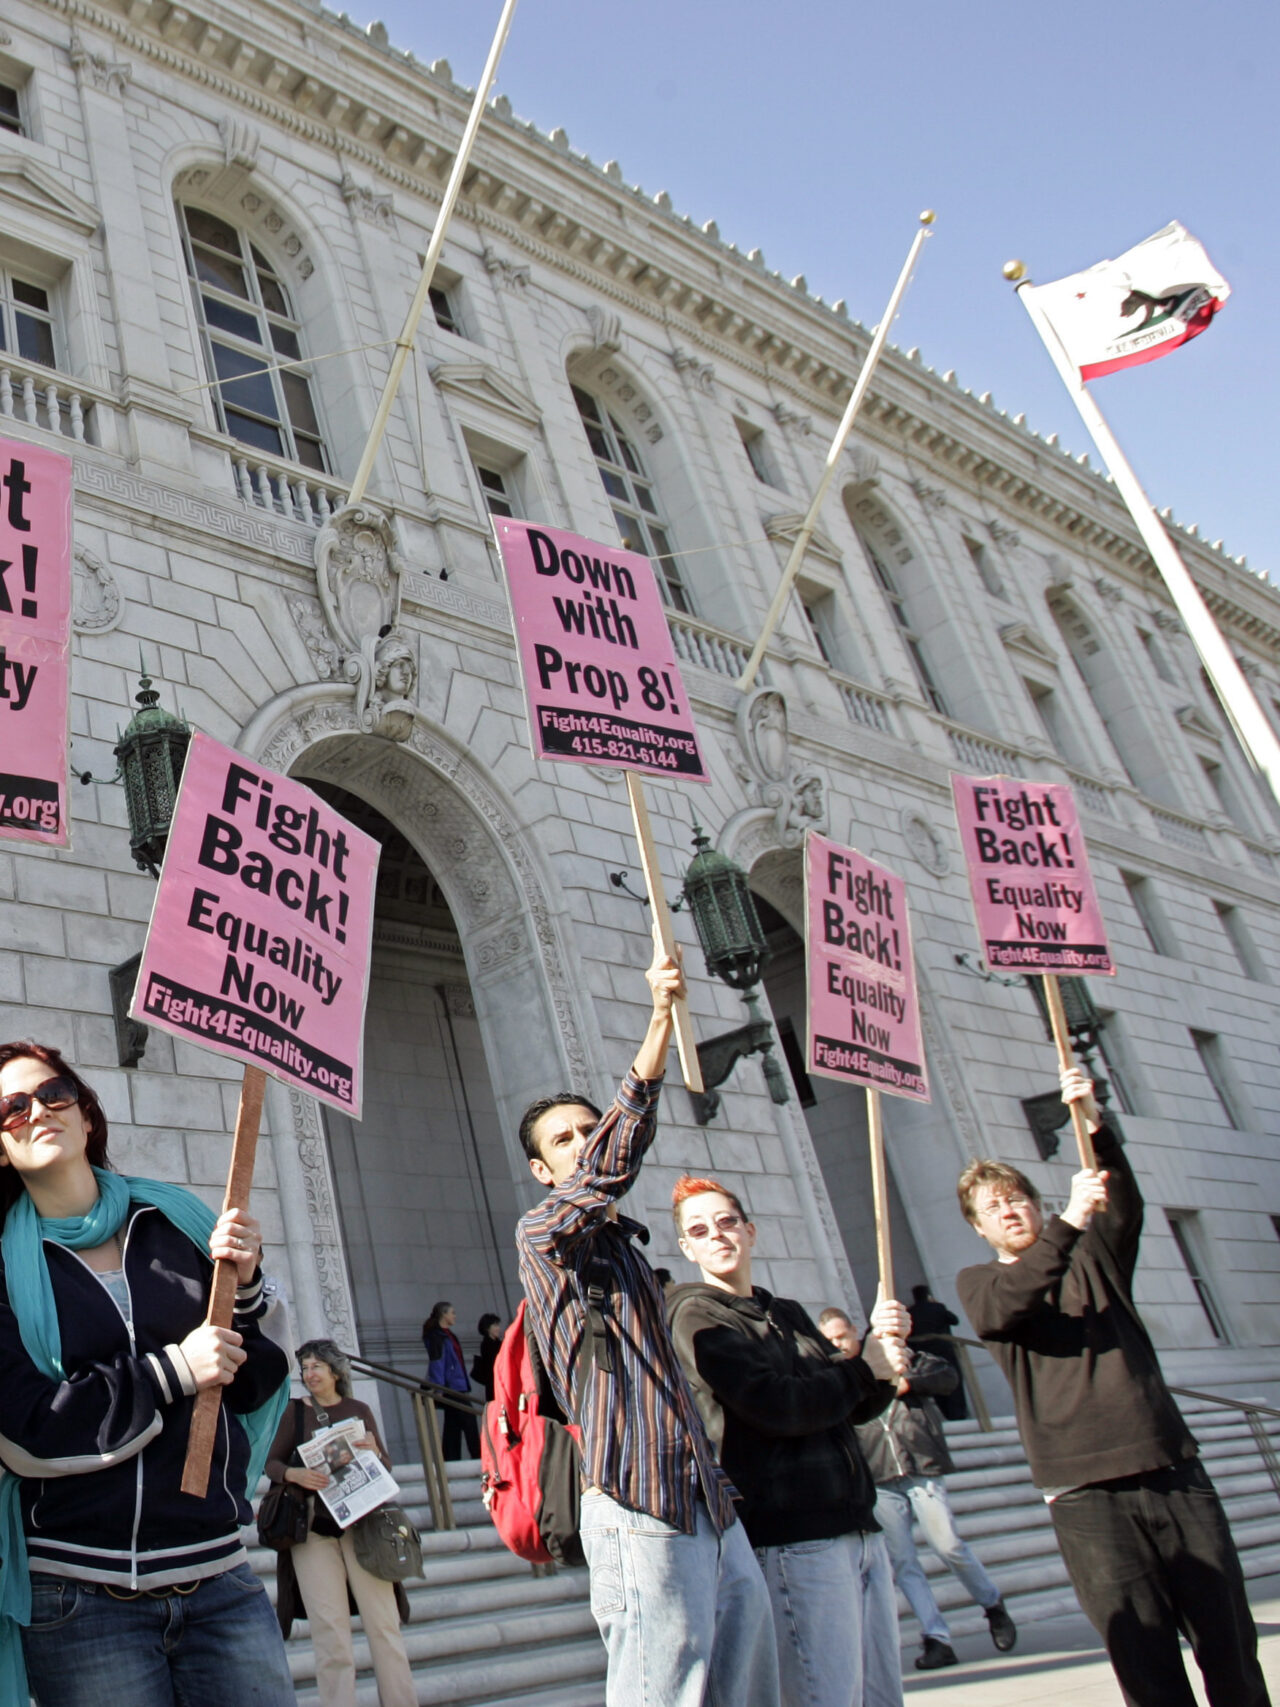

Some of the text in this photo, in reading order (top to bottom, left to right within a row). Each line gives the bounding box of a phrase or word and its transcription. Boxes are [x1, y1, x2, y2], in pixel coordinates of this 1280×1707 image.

[526, 528, 637, 600] Down
[552, 590, 639, 649] with
[534, 643, 680, 715] Prop 8!
[540, 710, 695, 755] Fight4Equality.org
[571, 736, 678, 768] 415-821-6144
[222, 762, 350, 883] Fight
[972, 787, 1061, 831] Fight
[974, 827, 1075, 868] Back!
[198, 813, 350, 945] Back!
[827, 851, 894, 921] Fight
[986, 878, 1083, 913] Equality
[187, 887, 342, 1005] Equality
[823, 899, 902, 971] Back!
[1016, 913, 1066, 940] Now
[988, 945, 1110, 969] Fight4Equality.org
[220, 954, 305, 1031] Now
[827, 961, 906, 1023] Equality
[147, 981, 351, 1100] Fight4Equality.org
[851, 1008, 890, 1052] Now
[815, 1042, 926, 1093] Fight4Equality.org
